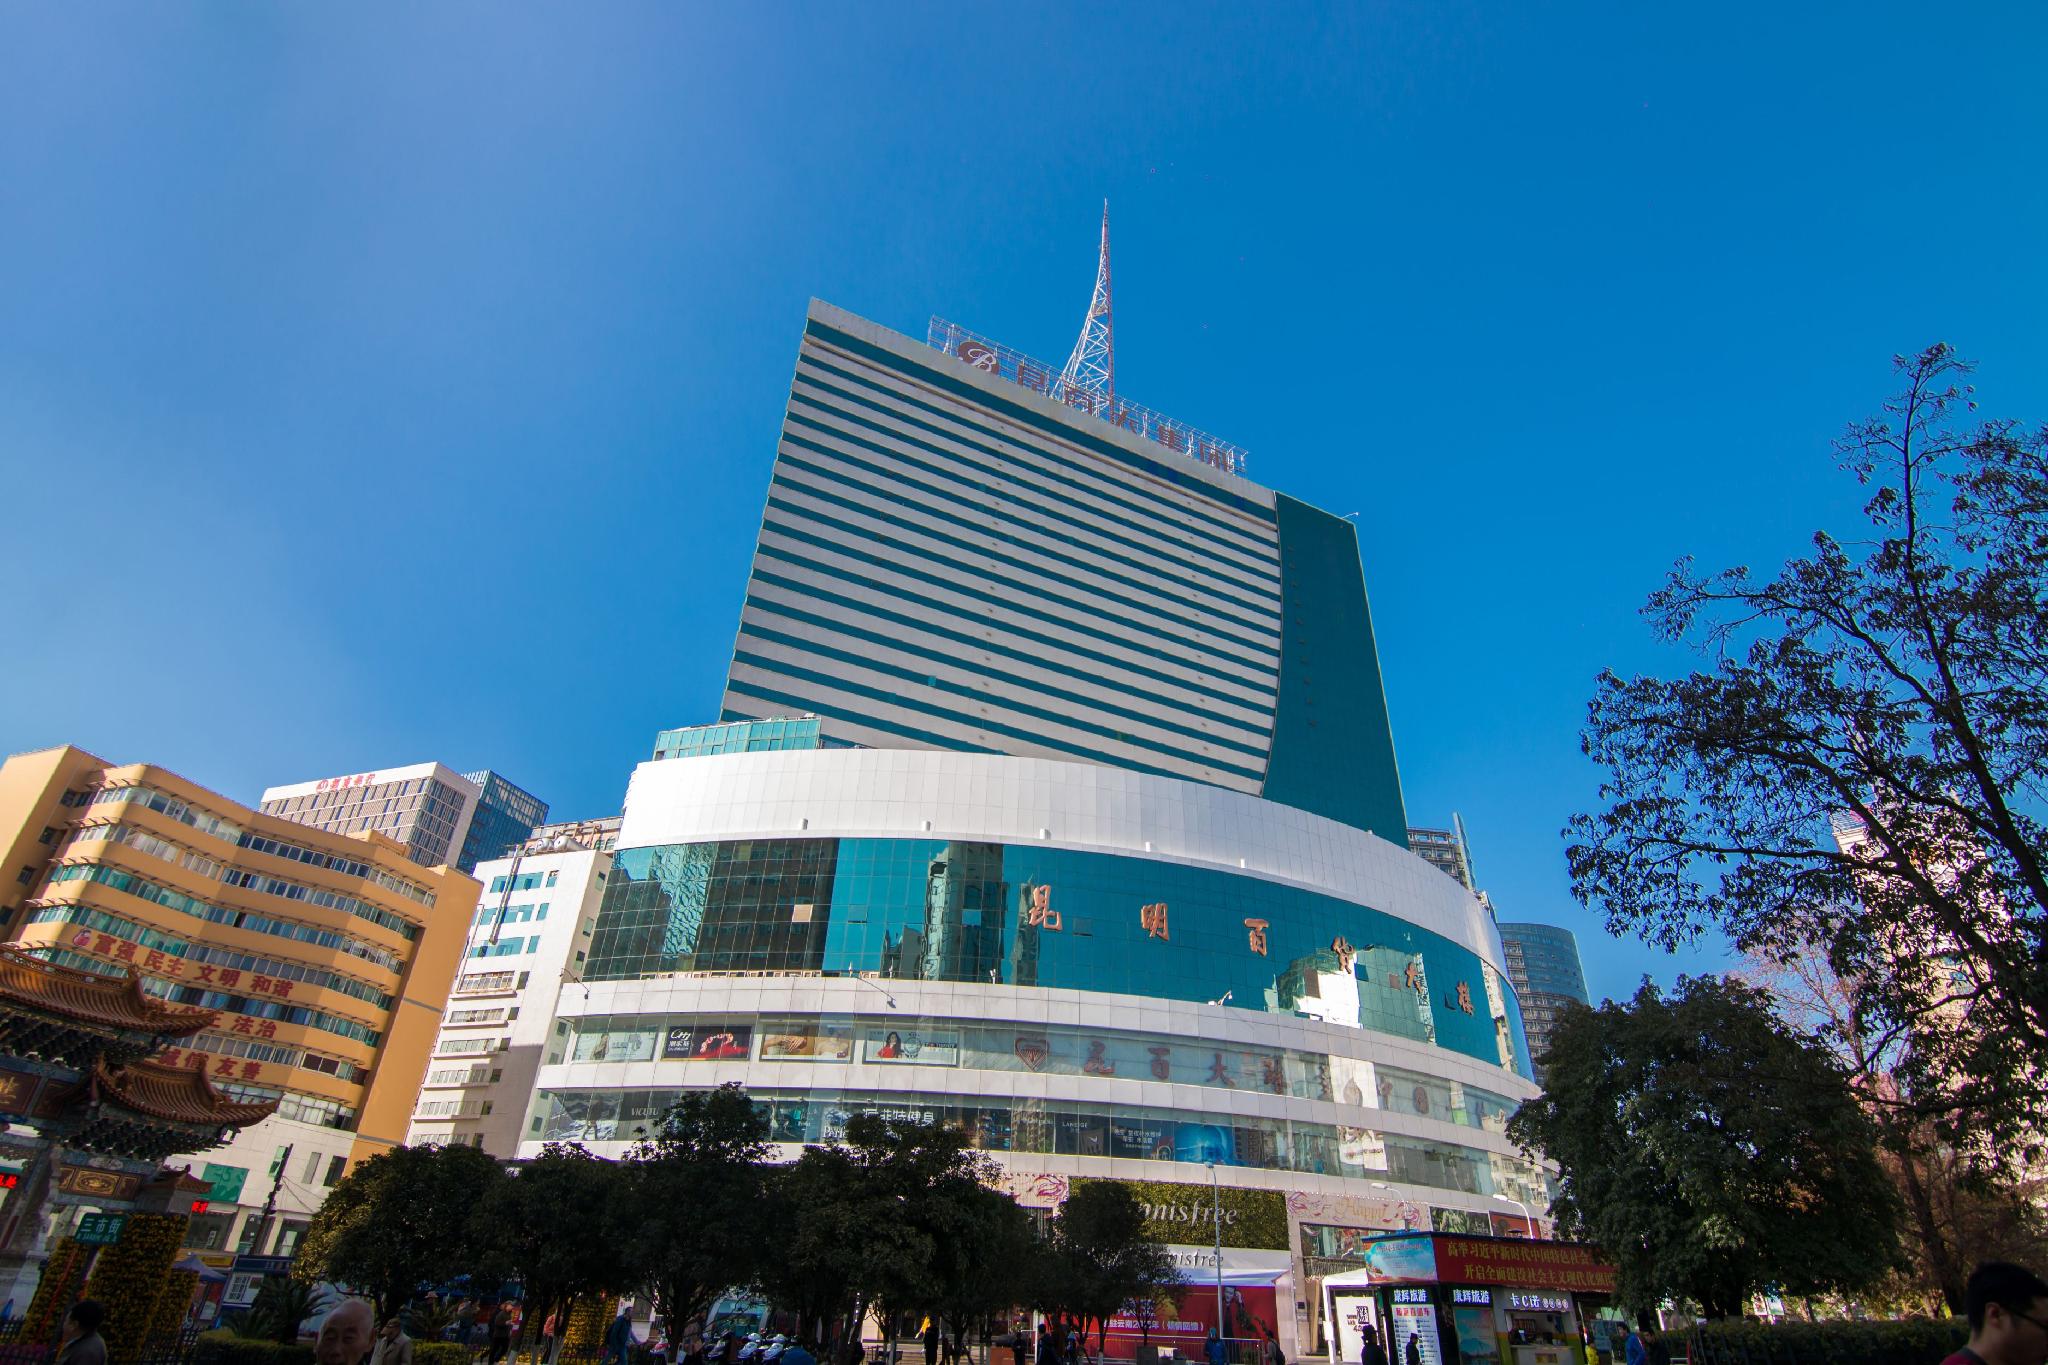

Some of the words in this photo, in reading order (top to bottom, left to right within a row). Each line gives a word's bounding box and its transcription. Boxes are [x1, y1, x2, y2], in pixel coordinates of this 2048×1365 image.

[92, 934, 138, 963] 富强
[144, 950, 185, 976] 民主
[194, 965, 241, 988] 文明
[250, 975, 294, 998] 和谐
[230, 1015, 278, 1039] 法治
[214, 1057, 264, 1081] 友善
[1138, 1200, 1238, 1227] nnisfree
